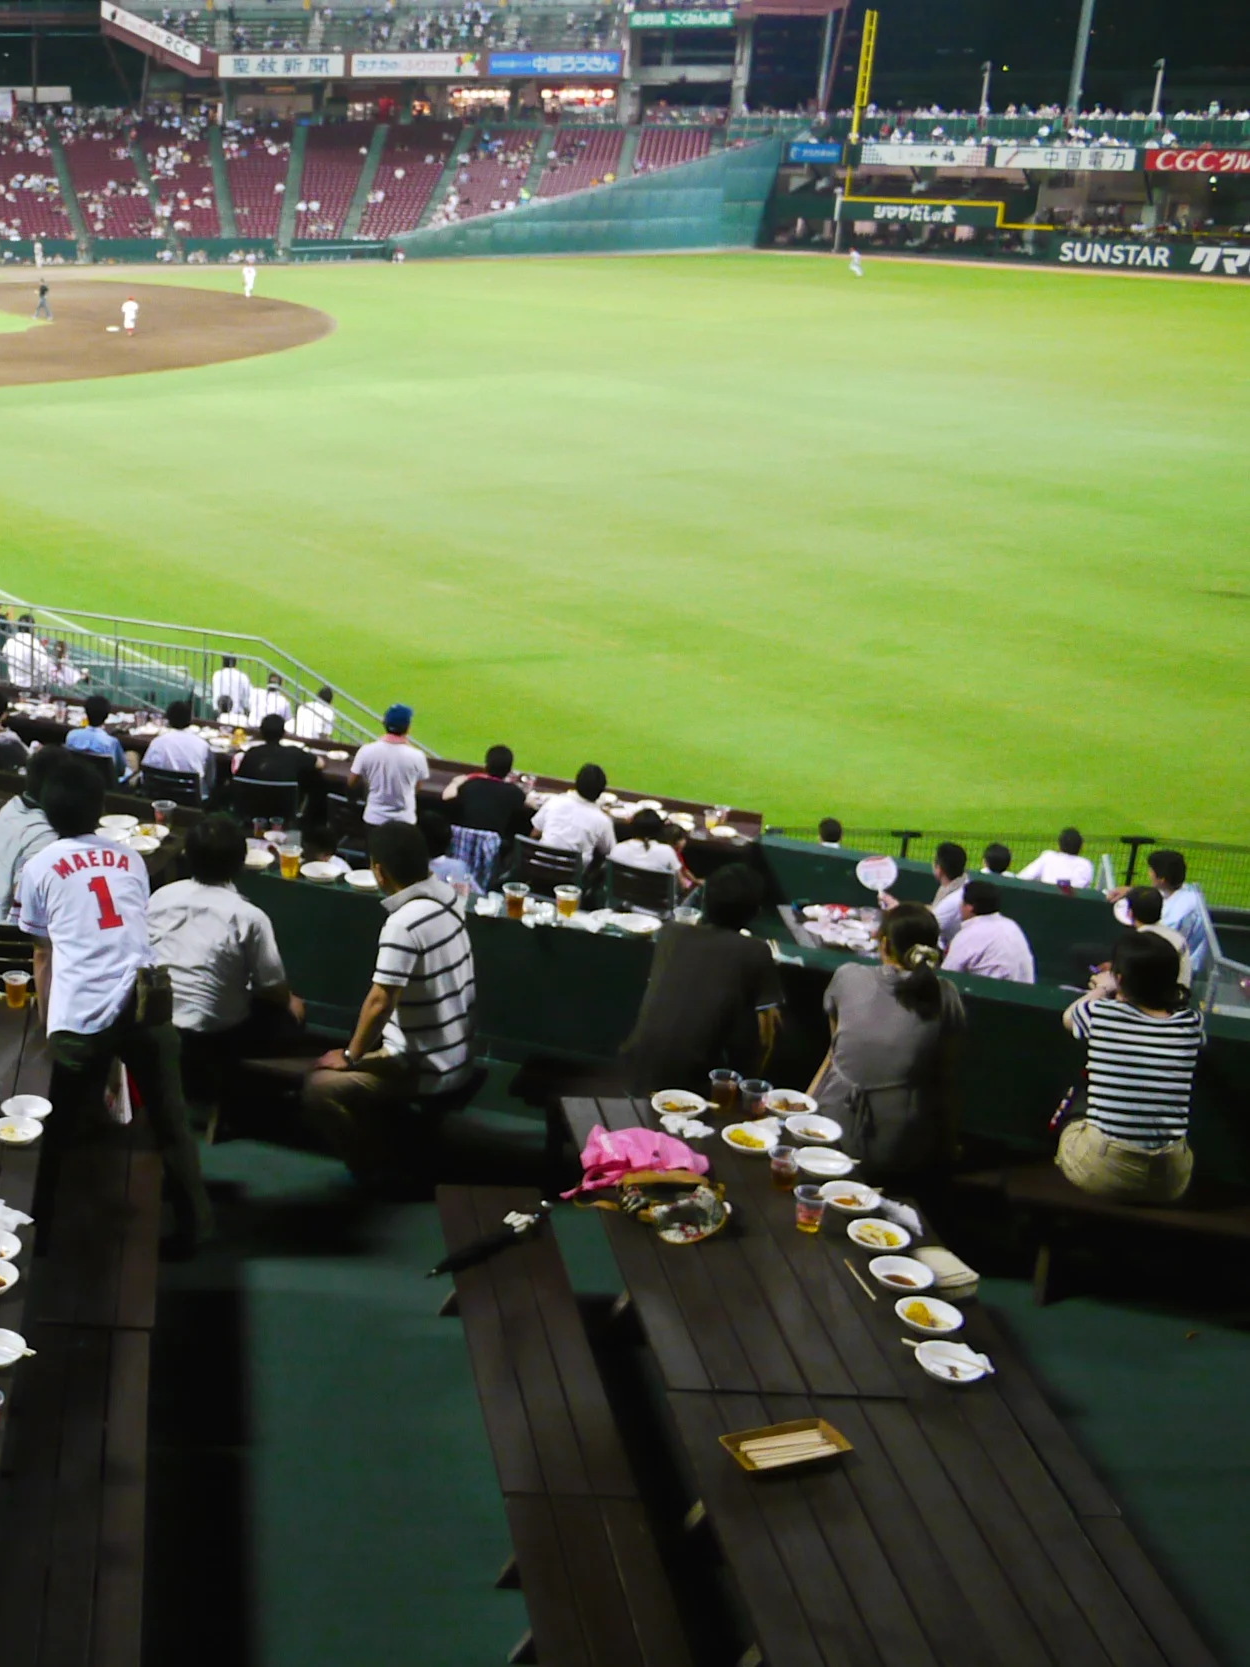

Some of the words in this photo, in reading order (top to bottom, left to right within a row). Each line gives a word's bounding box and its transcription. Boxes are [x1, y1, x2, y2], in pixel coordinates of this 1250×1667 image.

[164, 35, 192, 58] RCC
[232, 57, 329, 74] 聖教新聞
[1044, 151, 1126, 169] 中国電力
[873, 204, 957, 223] シマヤだしの素
[1058, 242, 1170, 267] SUNSTAR
[1189, 246, 1250, 275] クマ
[52, 849, 129, 880] MAEDA
[87, 875, 124, 930] 1
